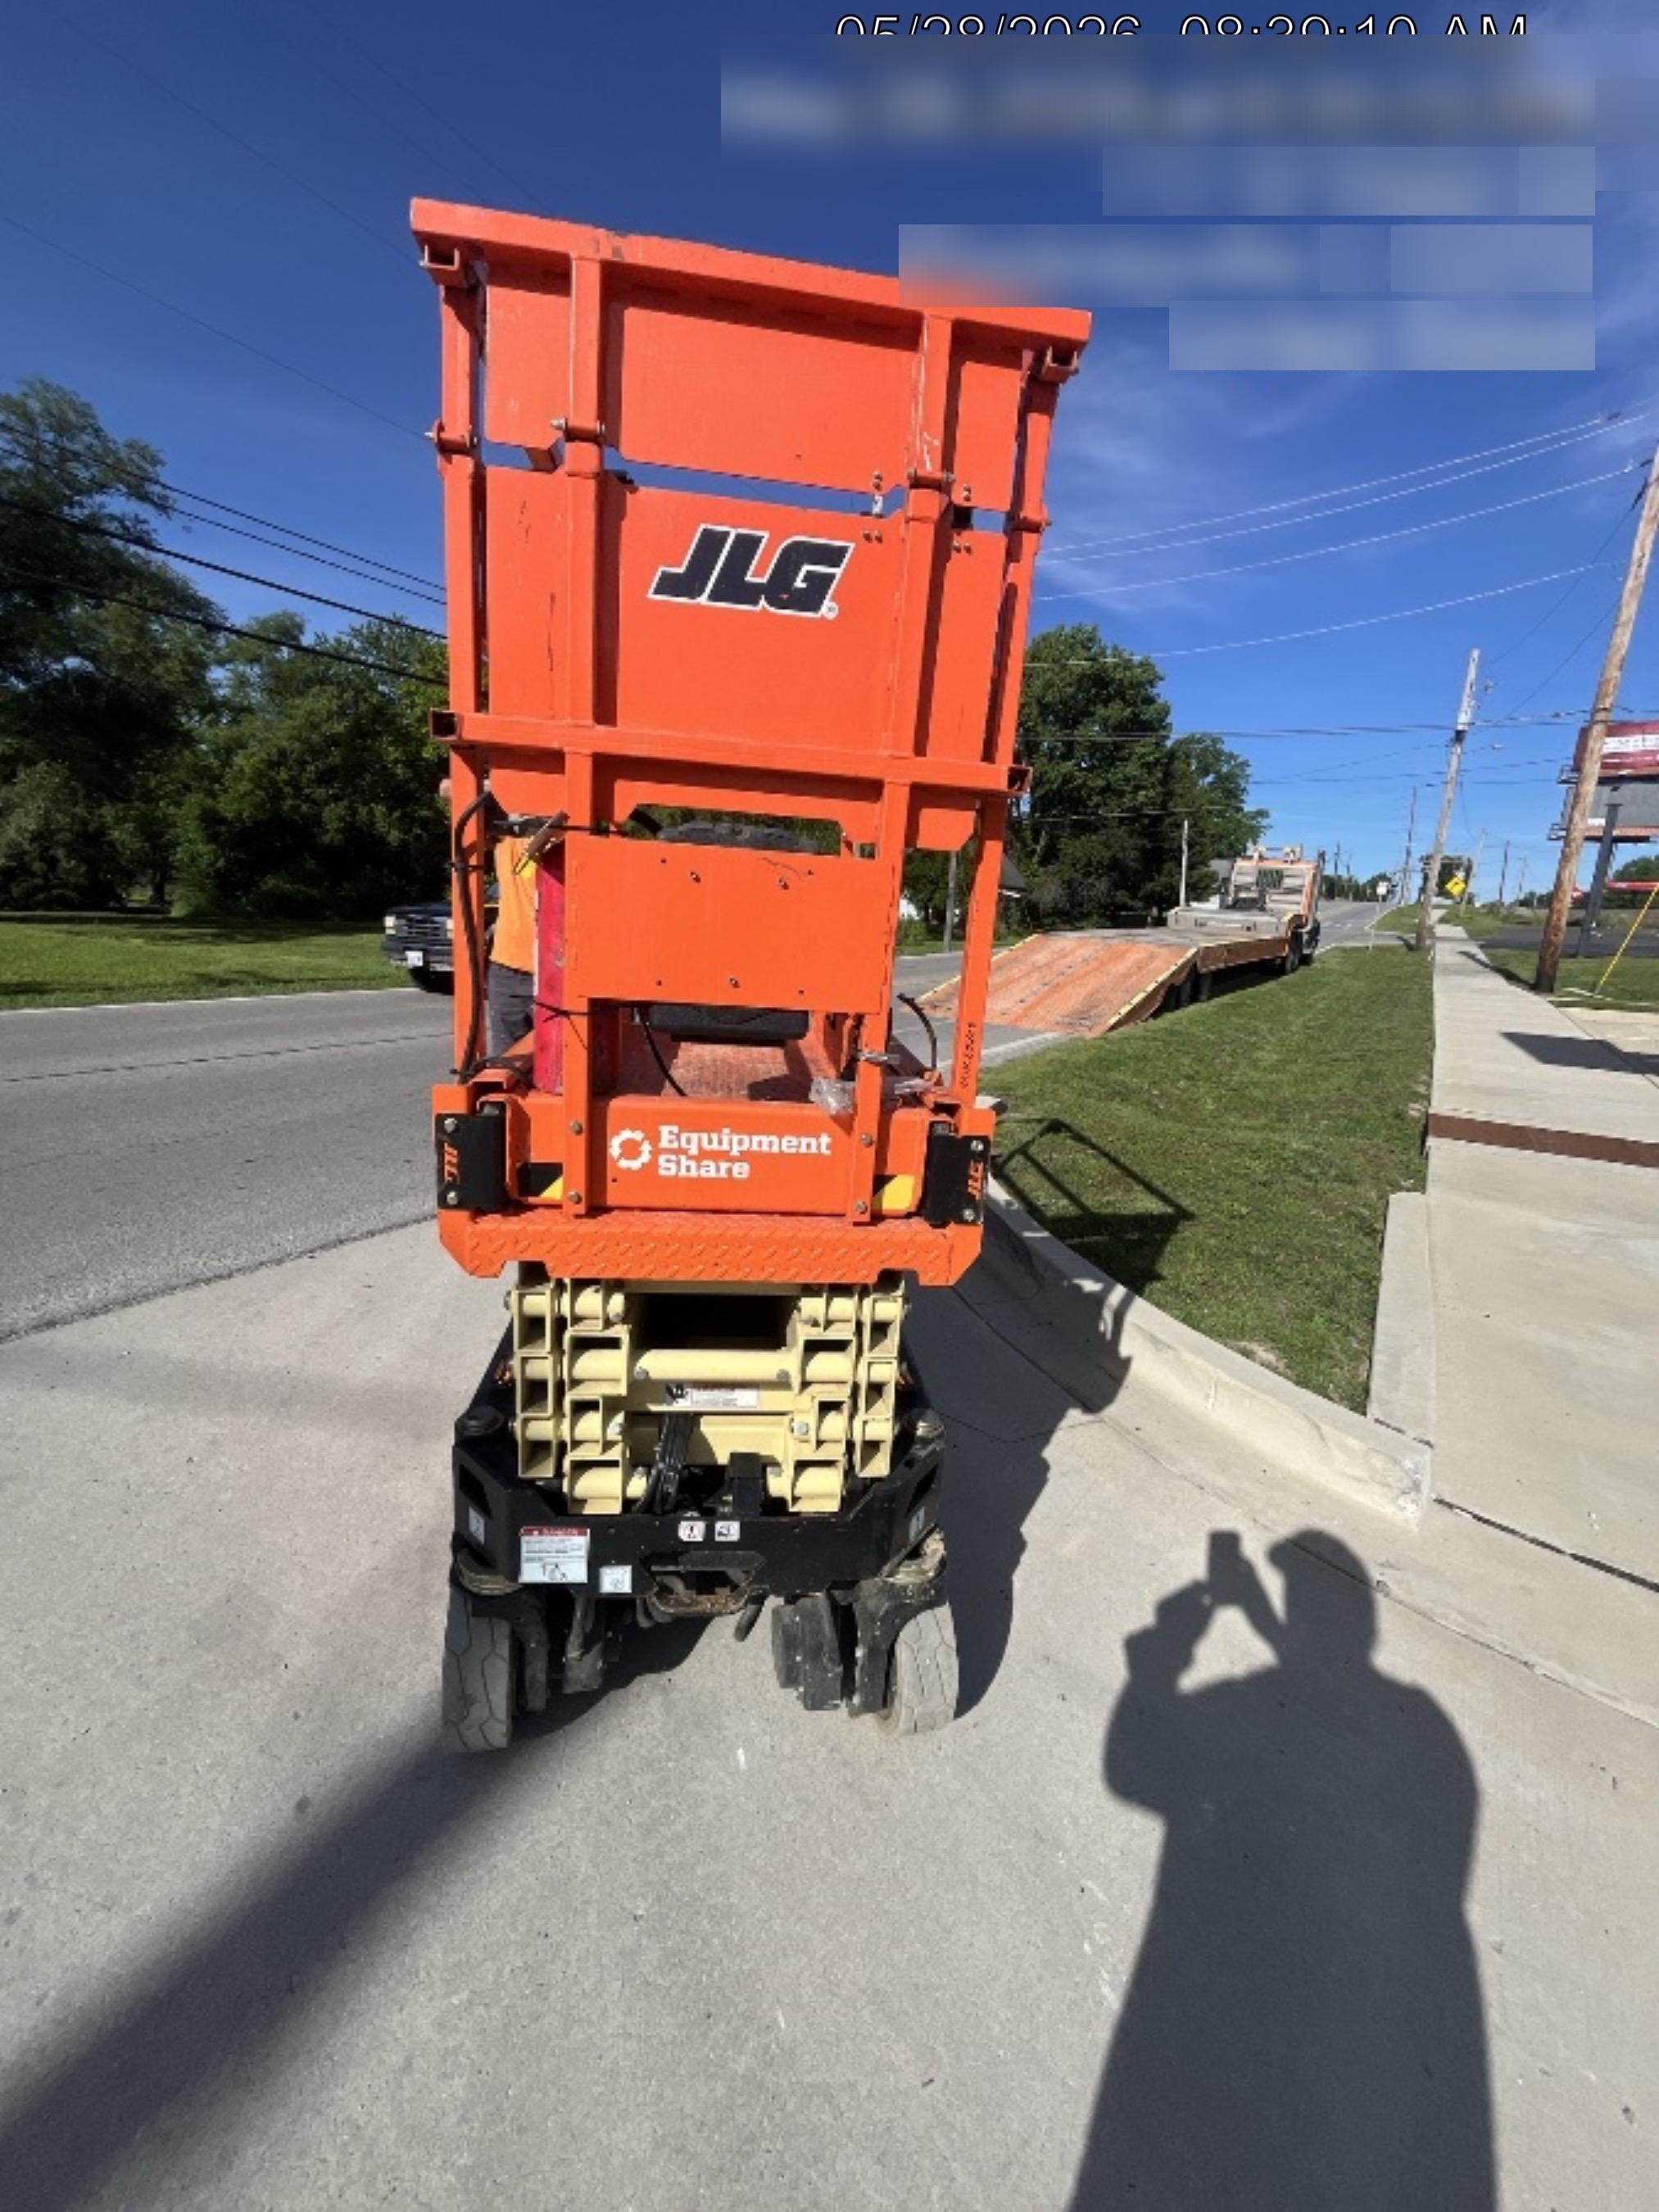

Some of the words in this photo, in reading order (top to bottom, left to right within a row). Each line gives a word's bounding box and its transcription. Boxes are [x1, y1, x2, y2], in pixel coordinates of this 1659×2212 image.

[646, 523, 856, 618] JLG
[658, 1125, 832, 1156] Equipment
[658, 1154, 750, 1178] Share
